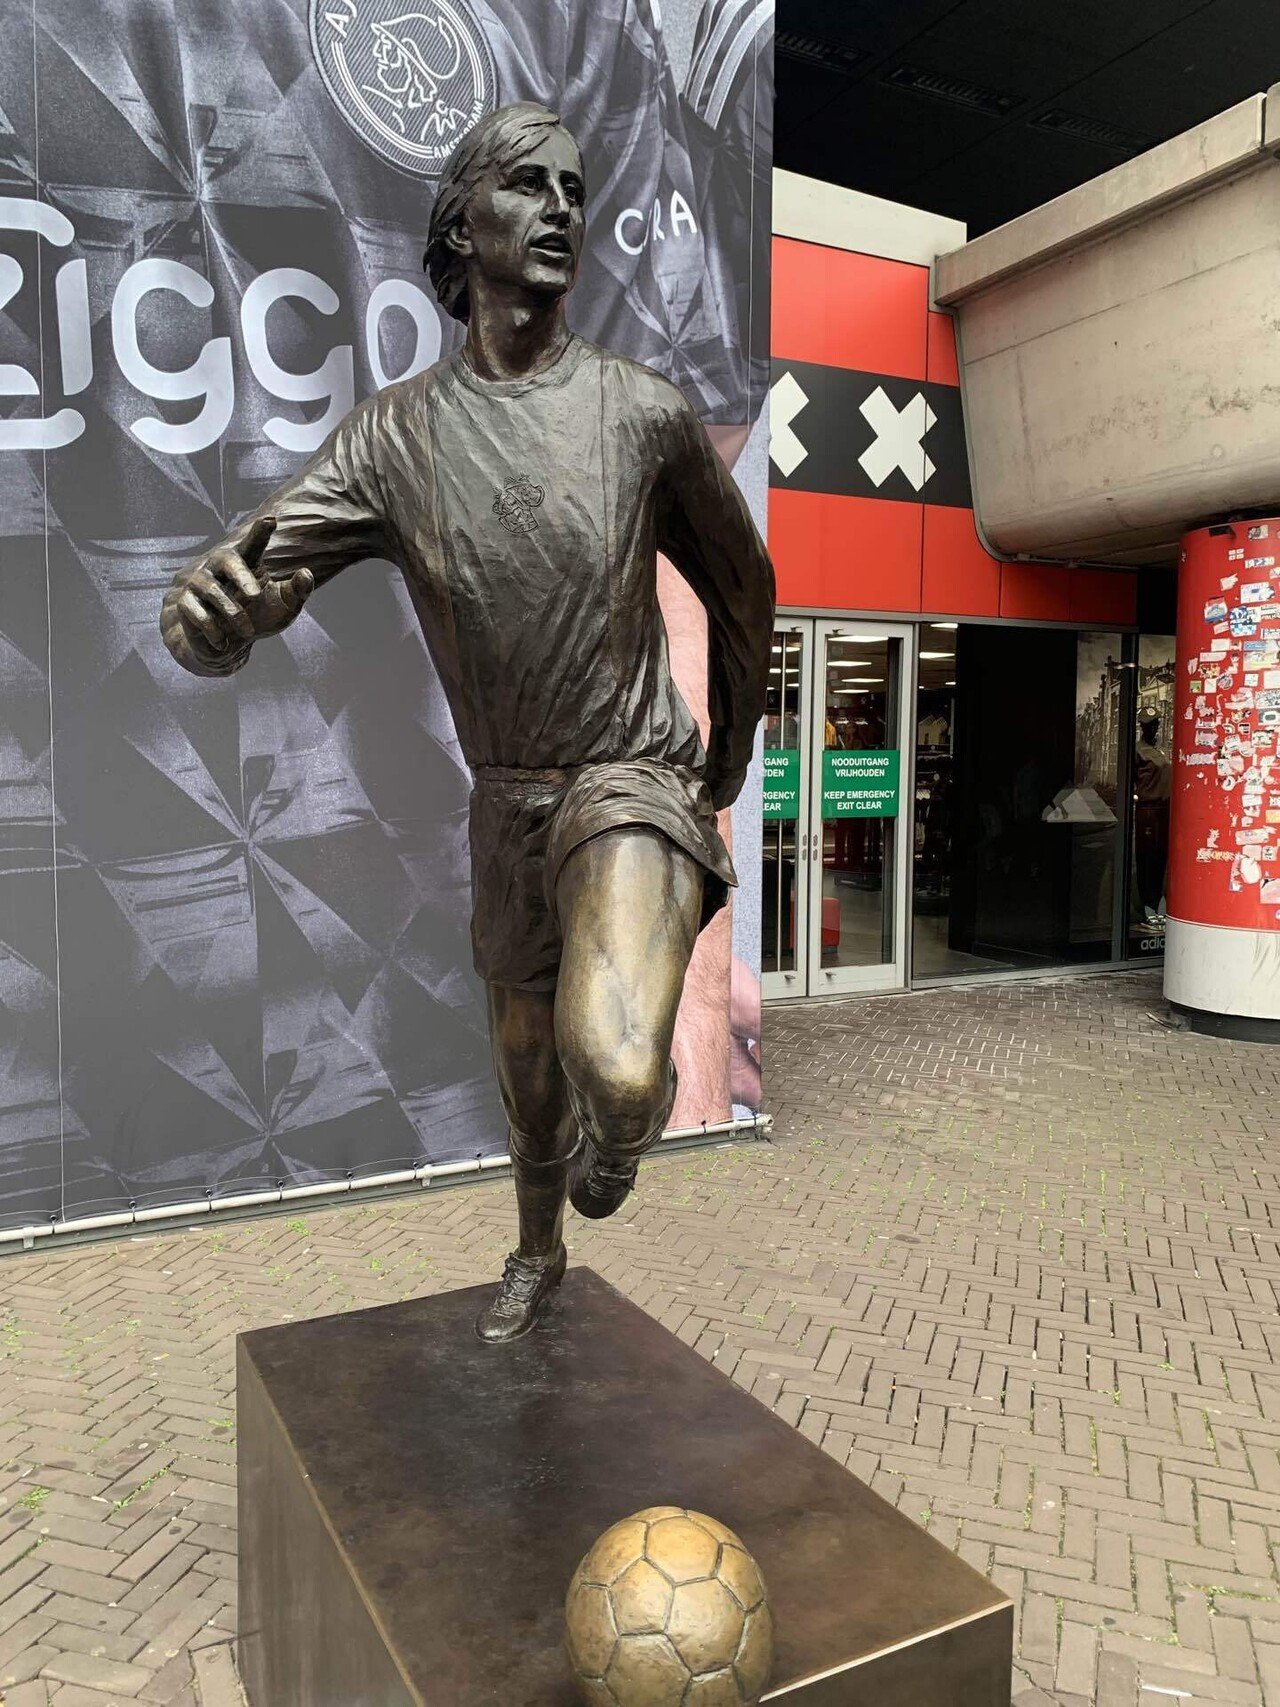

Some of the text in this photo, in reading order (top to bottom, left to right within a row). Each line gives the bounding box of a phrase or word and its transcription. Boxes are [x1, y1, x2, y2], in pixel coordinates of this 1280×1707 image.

[763, 757, 789, 766] GANG
[831, 758, 890, 767] NOODUITGANG
[765, 768, 785, 778] DEN
[835, 769, 885, 778] VRIJHOUDEN
[824, 790, 896, 800] KEEP EMERGENCY
[763, 802, 782, 812] EAR
[837, 801, 882, 811] EXIT CLEAR
